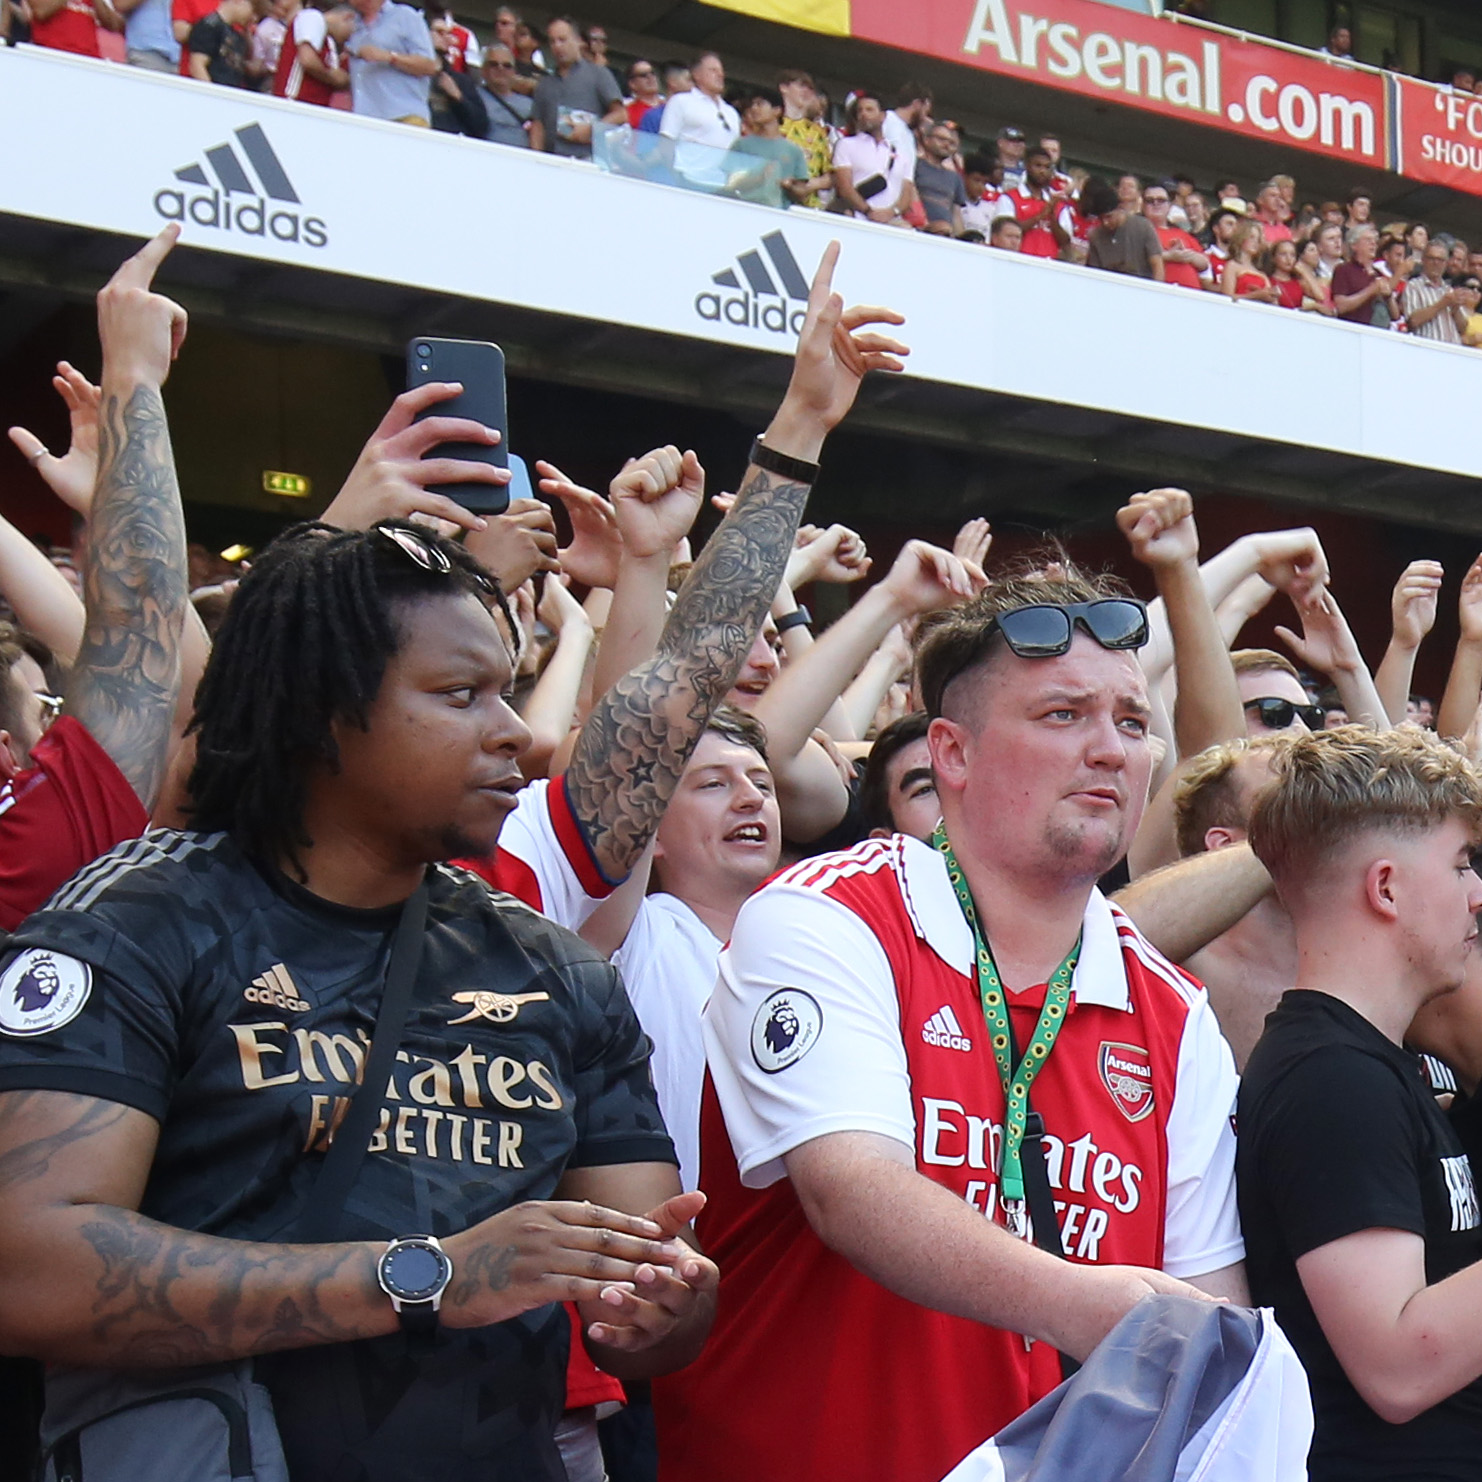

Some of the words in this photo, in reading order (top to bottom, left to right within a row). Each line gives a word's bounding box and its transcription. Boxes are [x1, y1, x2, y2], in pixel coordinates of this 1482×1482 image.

[963, 0, 1374, 155] Arsenal.com
[153, 186, 329, 248] adidas
[243, 985, 312, 1012] adidas
[922, 1029, 972, 1052] adidas
[1106, 1054, 1151, 1077] Arsenal
